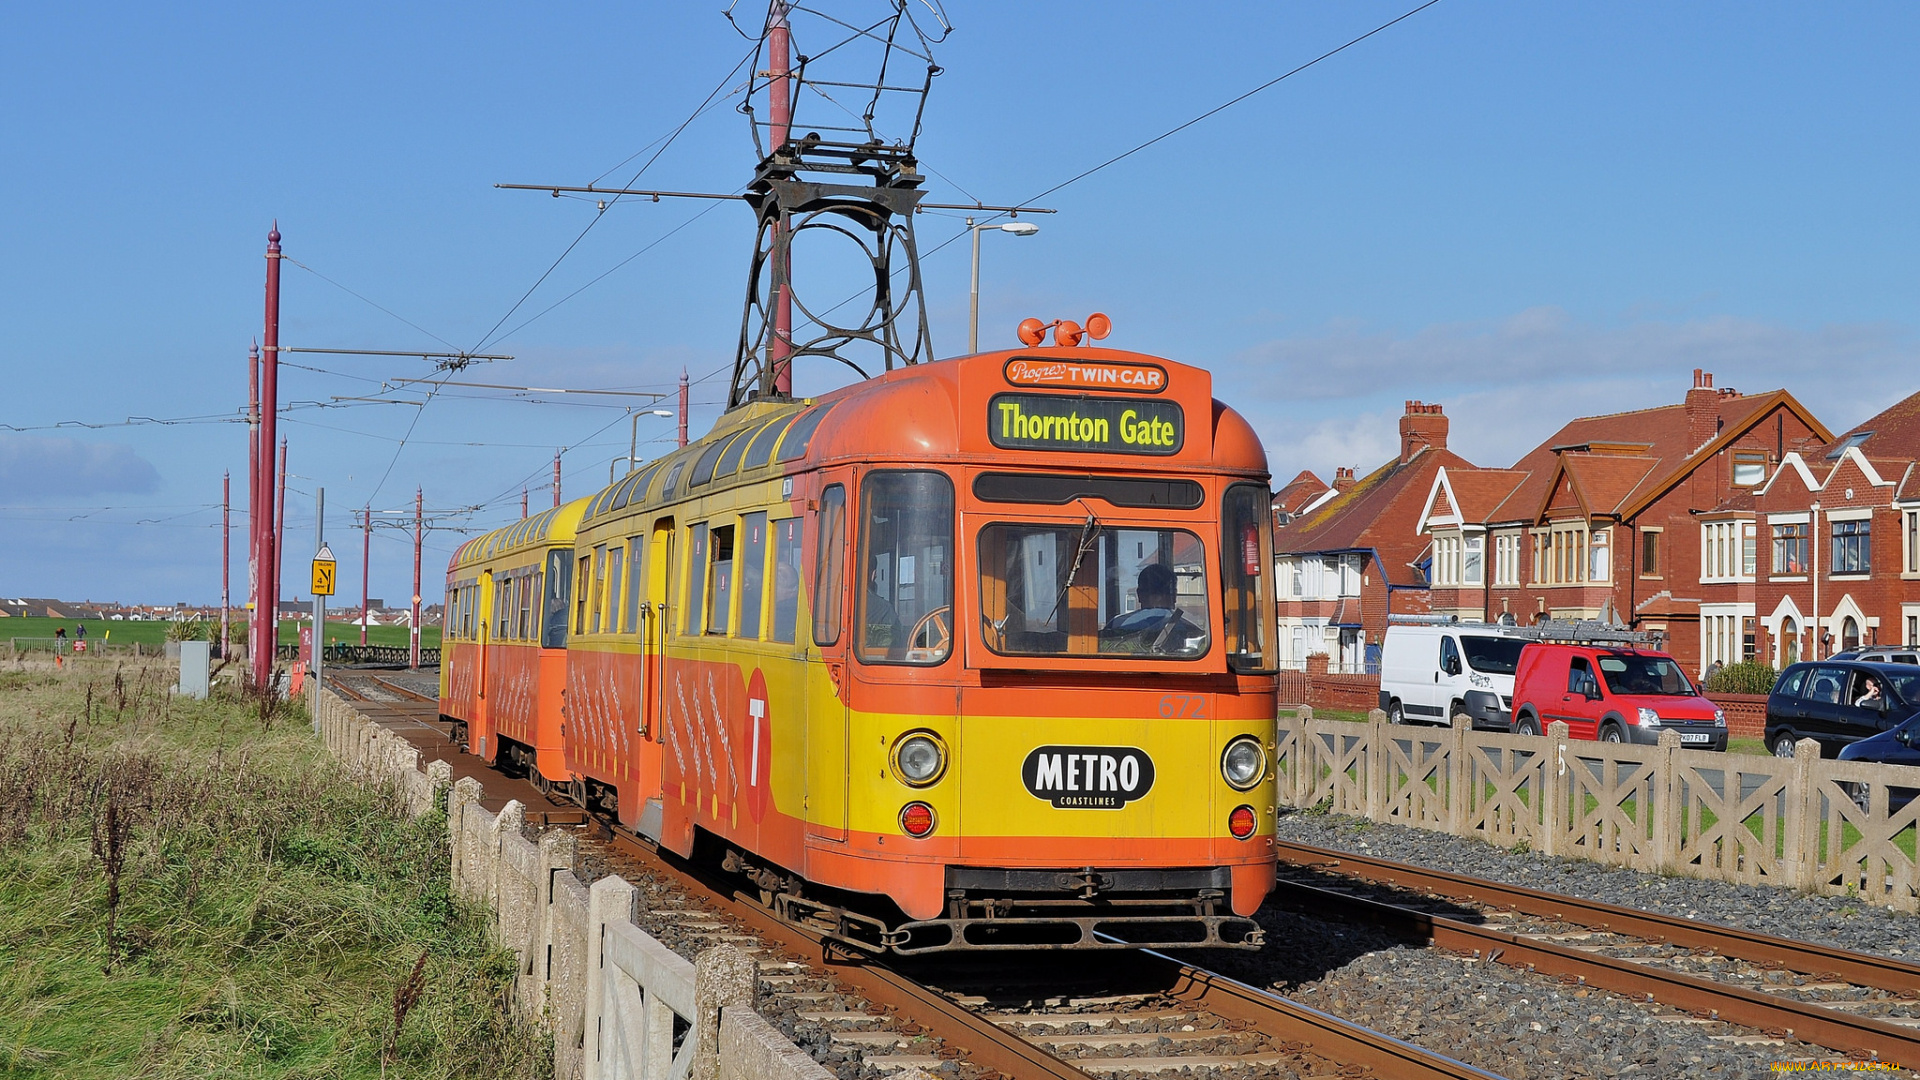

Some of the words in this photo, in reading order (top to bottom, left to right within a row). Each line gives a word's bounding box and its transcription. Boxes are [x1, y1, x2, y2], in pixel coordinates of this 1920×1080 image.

[1012, 362, 1066, 383] Progress
[998, 403, 1109, 442] Thornton
[1119, 409, 1174, 446] Gate
[1158, 695, 1206, 718] 672
[1035, 754, 1140, 792] METRO
[1558, 744, 1567, 776] 5
[1060, 796, 1115, 806] COASTLINES
